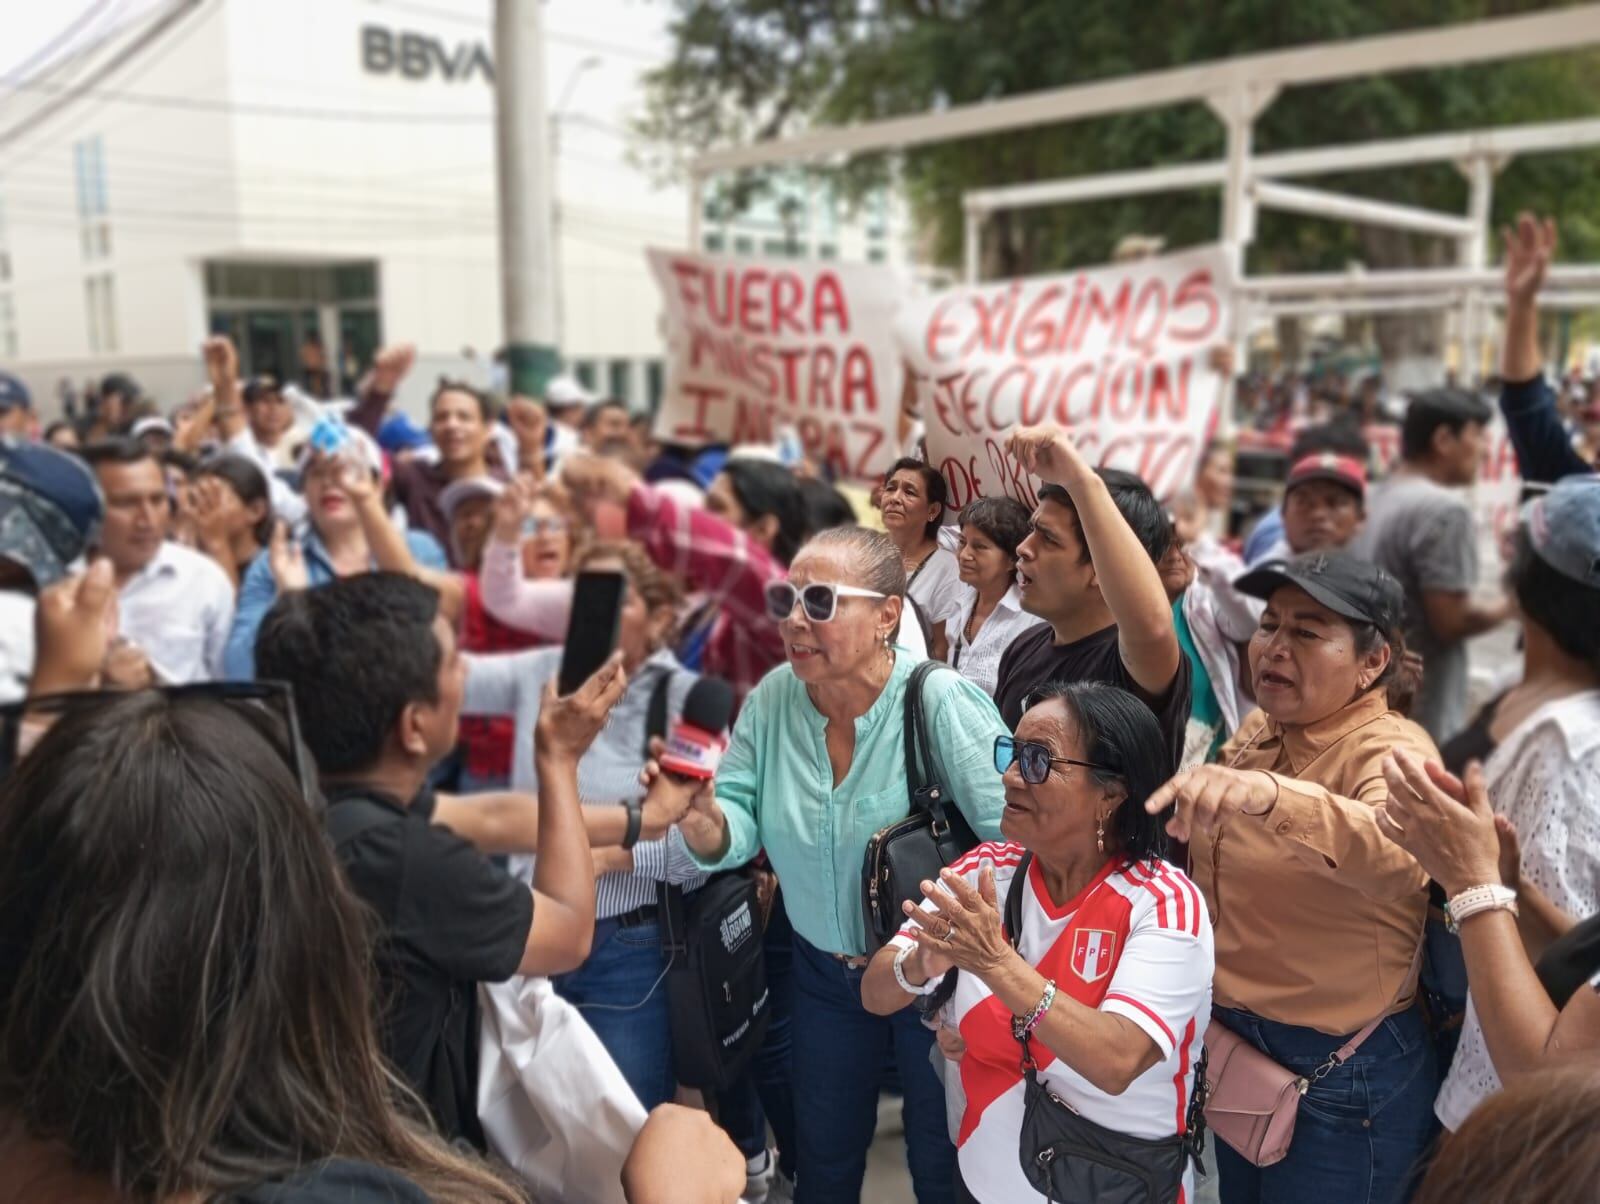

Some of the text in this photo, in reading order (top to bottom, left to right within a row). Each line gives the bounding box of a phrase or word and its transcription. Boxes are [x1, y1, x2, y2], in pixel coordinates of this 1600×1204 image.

[360, 25, 496, 83] BBVA
[672, 259, 849, 334] FUERA
[939, 456, 983, 511] DE
